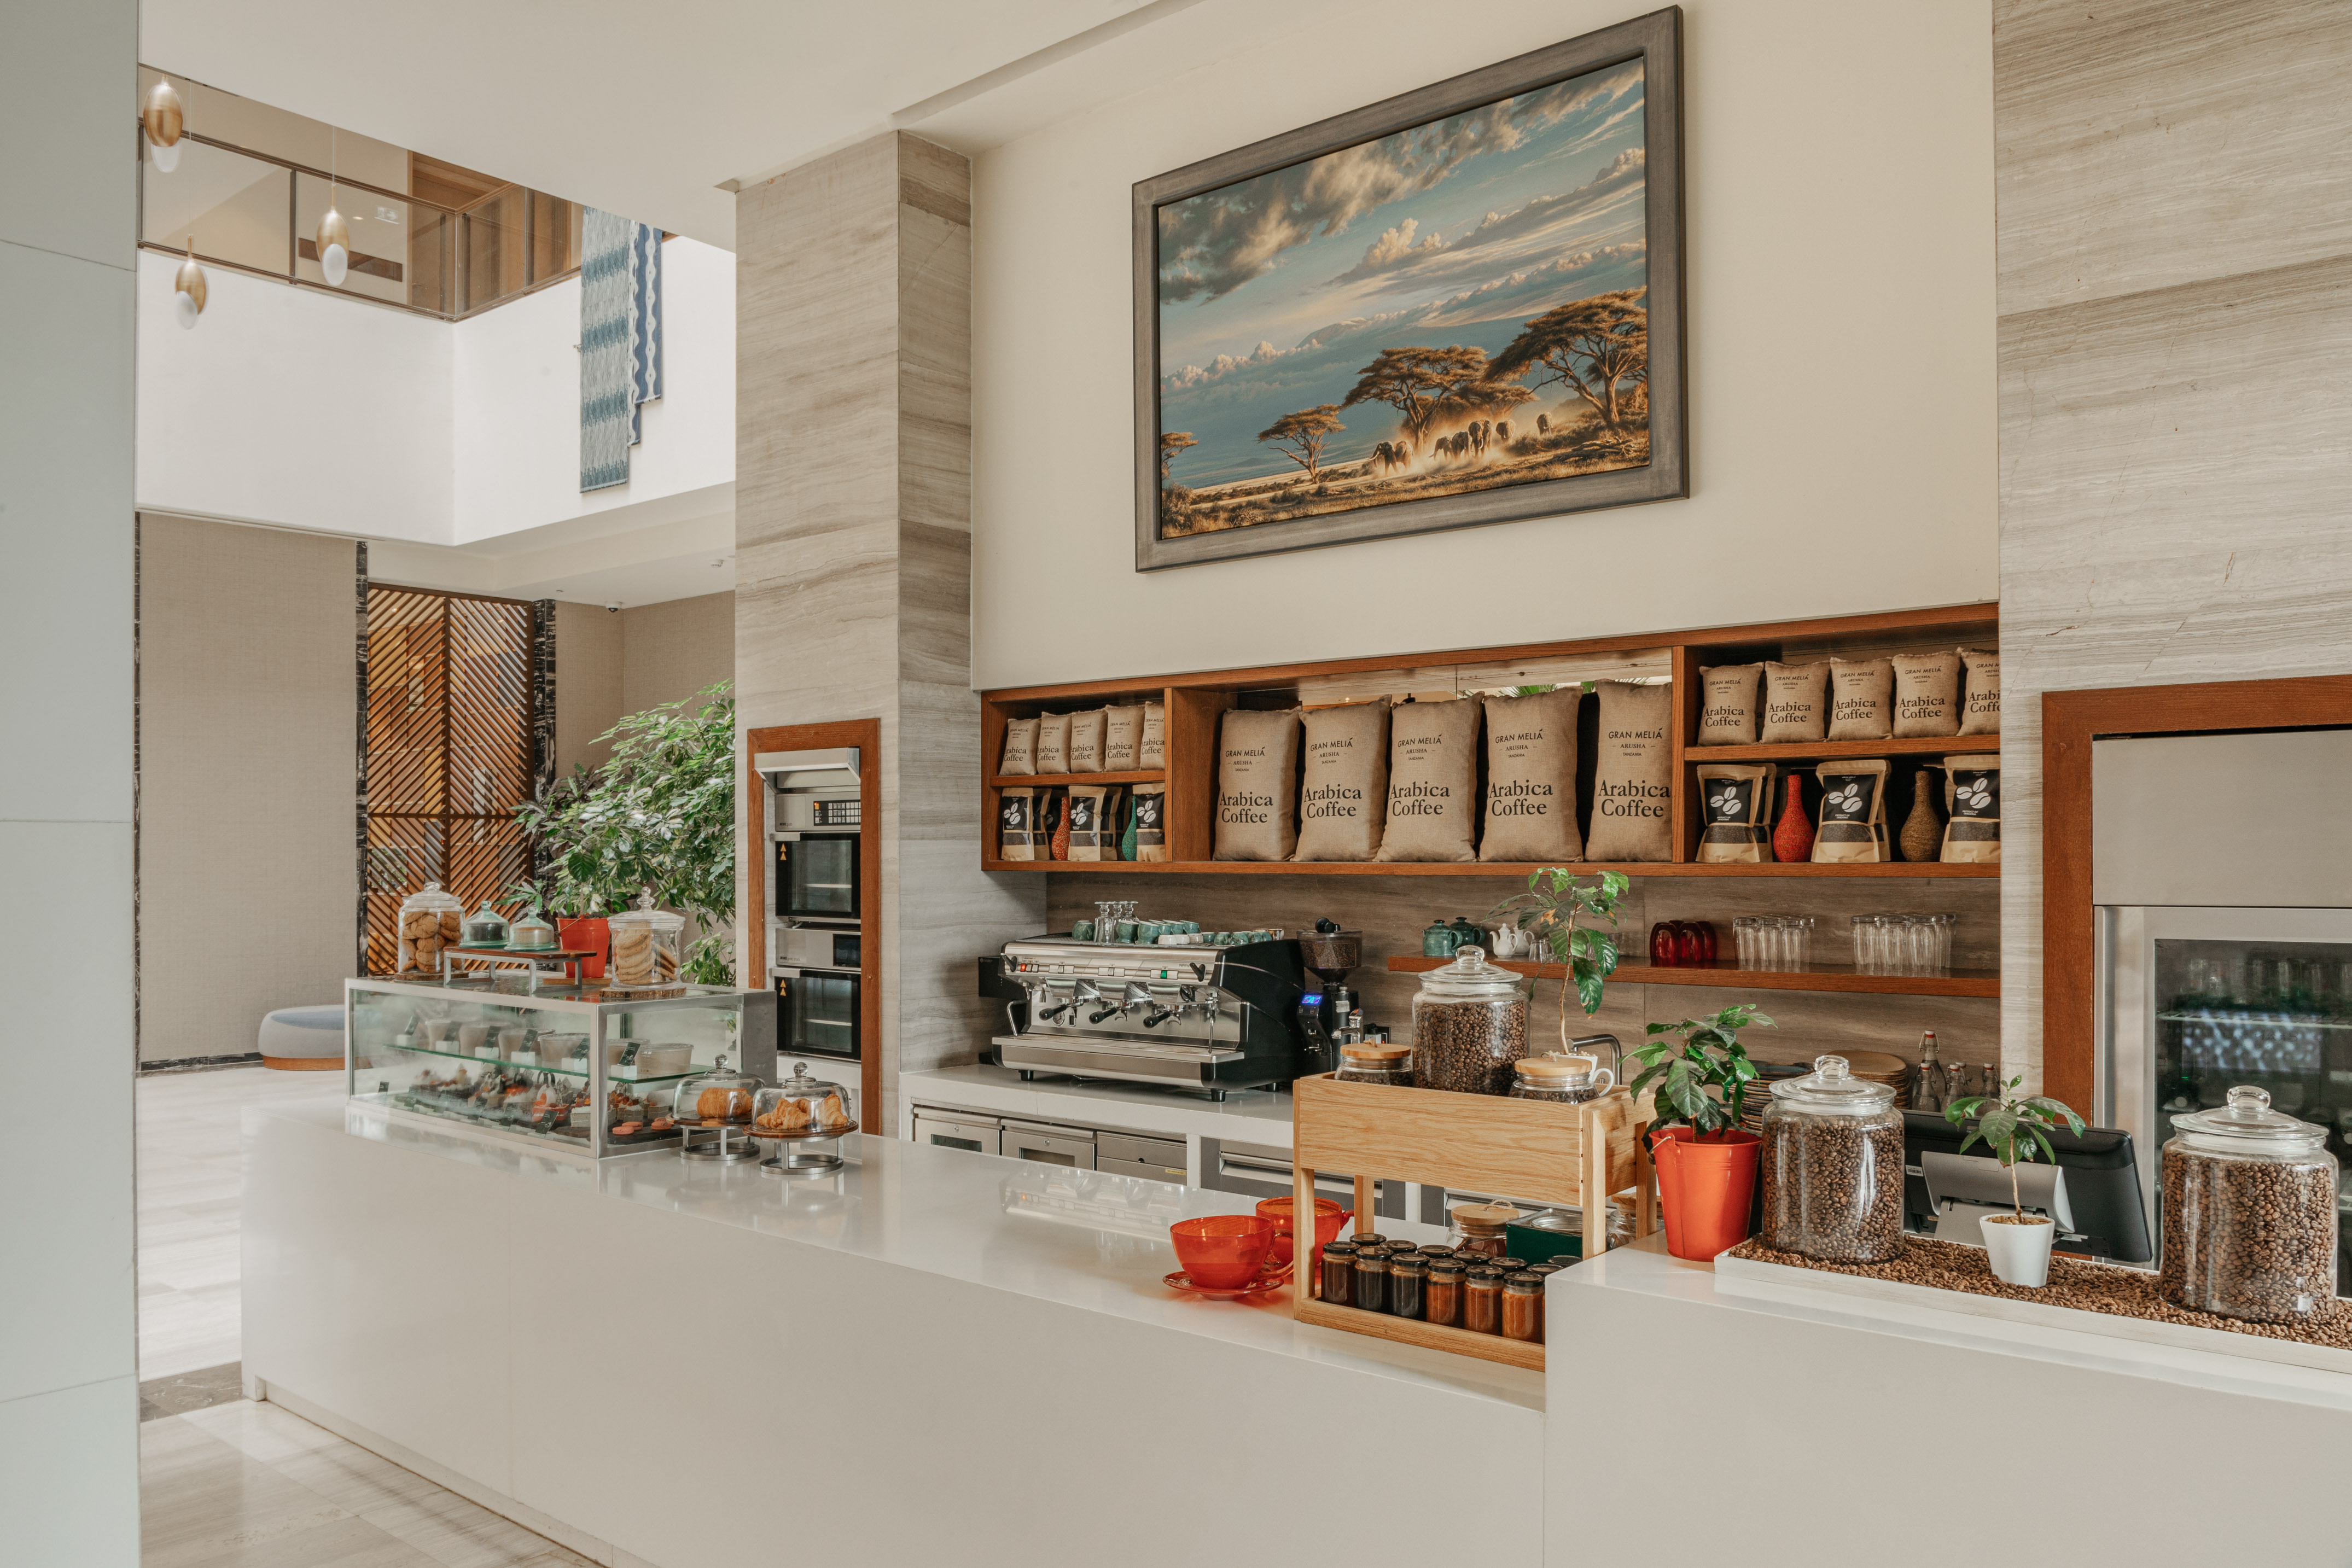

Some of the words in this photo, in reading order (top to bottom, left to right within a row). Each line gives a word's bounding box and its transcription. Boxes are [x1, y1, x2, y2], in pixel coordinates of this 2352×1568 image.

[1899, 696, 1945, 708] Arabica
[1969, 690, 2000, 702] Arabi
[1769, 702, 1811, 712] Arabica
[1834, 698, 1876, 710] Arabica
[1704, 706, 1744, 717] Arabica
[1836, 709, 1872, 720] Coffee
[1902, 708, 1942, 719] Coffee
[1705, 716, 1740, 727] Coffee
[1771, 713, 1807, 723] Coffee
[1495, 734, 1515, 744] GRAN
[1517, 728, 1543, 741] MELIÁ
[1635, 727, 1662, 738] MELIÁ
[1107, 742, 1132, 750] Arabica
[1311, 742, 1328, 751] GRAN
[1330, 737, 1353, 747] MELIÁ
[1398, 738, 1416, 747] GRAN
[1418, 734, 1442, 744] MELIÁ
[1108, 750, 1130, 759] Coffee
[1142, 747, 1161, 755] Coffee
[1244, 747, 1265, 756] MELIÁ
[1304, 784, 1362, 802] Arabica
[1389, 781, 1450, 800] Arabica
[1489, 779, 1553, 798] Arabica
[1598, 779, 1670, 797] Arabica
[1220, 791, 1273, 806] Arabica
[1307, 801, 1356, 818] Coffee
[1393, 799, 1443, 816] Coffee
[1492, 798, 1547, 816] Coffee
[1602, 799, 1664, 817] Coffee
[1222, 808, 1267, 823] Coffee
